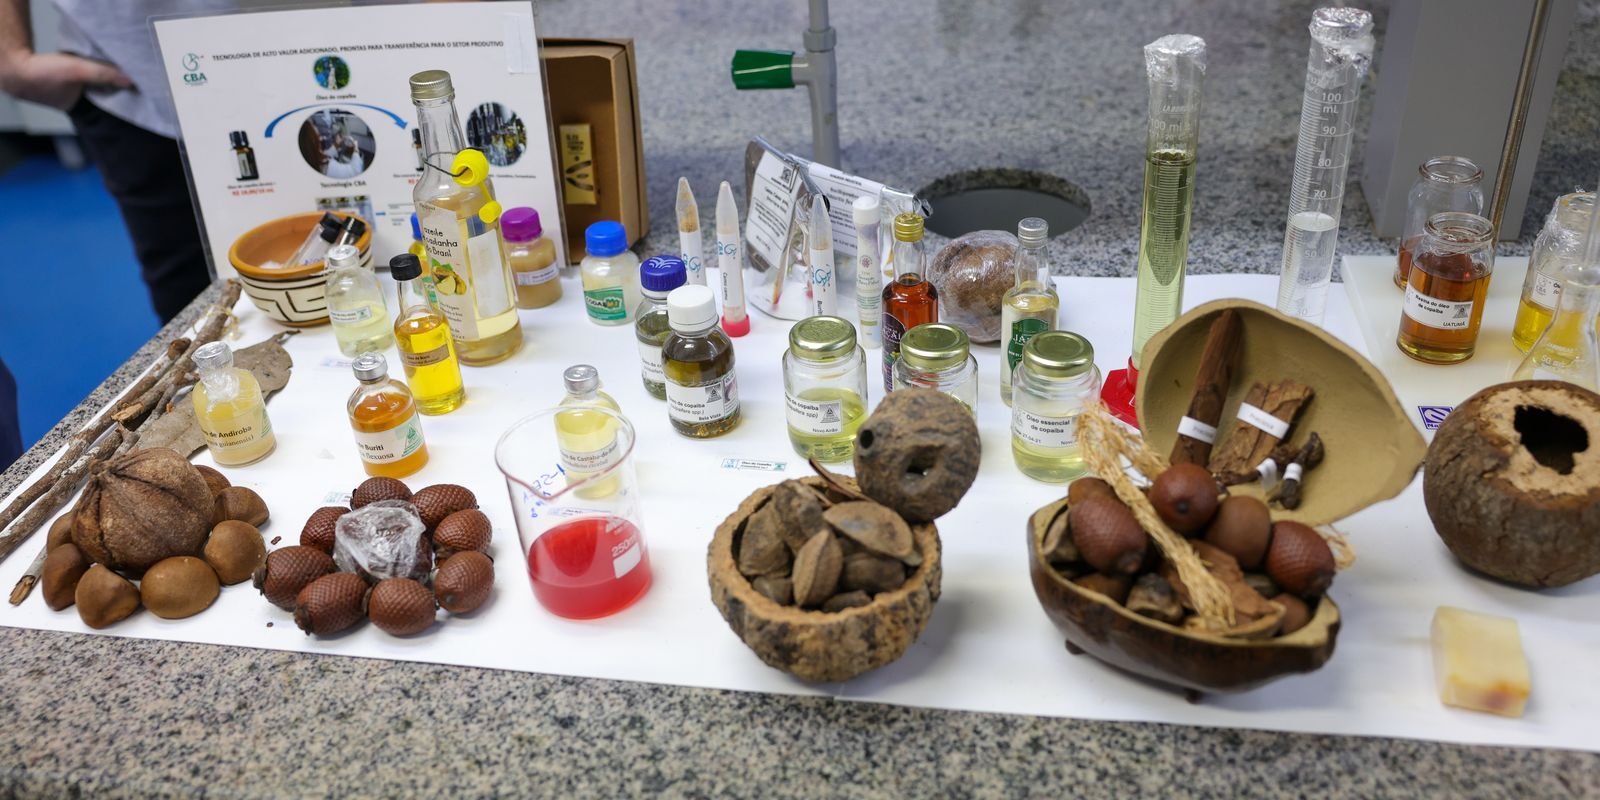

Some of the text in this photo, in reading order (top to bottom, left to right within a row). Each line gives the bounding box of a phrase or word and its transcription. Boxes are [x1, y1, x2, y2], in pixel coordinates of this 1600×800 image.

[212, 53, 251, 61] TECNOLOGIA
[470, 40, 504, 48] PRODUTIVO
[183, 72, 208, 83] CBA
[1322, 92, 1342, 102] 100
[1322, 104, 1339, 114] mL
[1322, 126, 1337, 136] 90
[1318, 158, 1332, 168] 80
[1313, 189, 1327, 200] 70
[1040, 419, 1071, 427] essencial
[218, 425, 252, 439] Andiroba
[364, 443, 385, 451] Buriti
